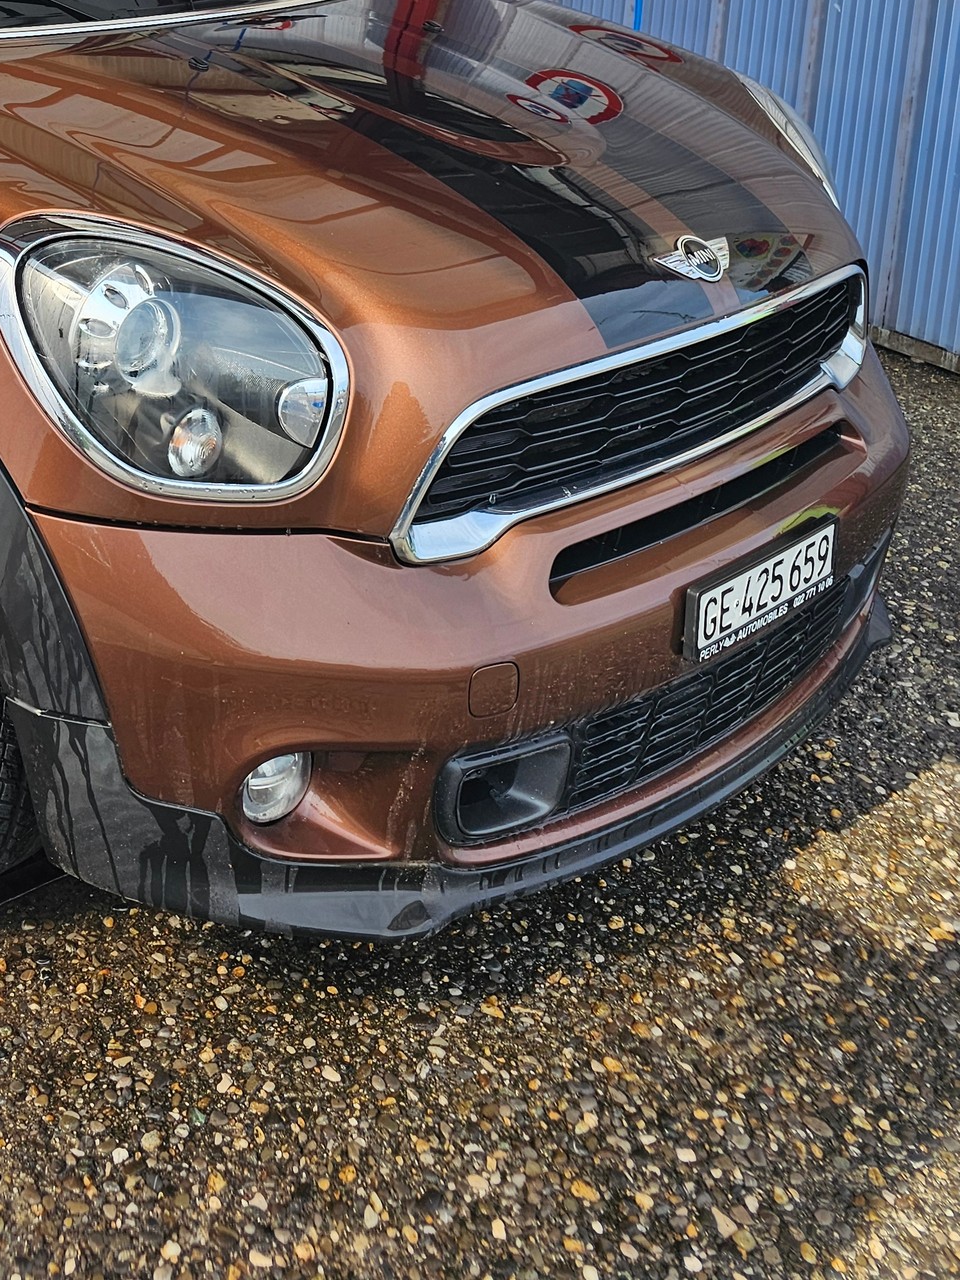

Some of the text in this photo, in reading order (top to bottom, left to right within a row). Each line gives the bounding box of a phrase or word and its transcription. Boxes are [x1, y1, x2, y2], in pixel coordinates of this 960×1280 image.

[687, 248, 716, 266] MINI
[790, 534, 830, 593] 659
[699, 638, 725, 663] PERLY
[736, 603, 789, 642] AUTOMOBILES
